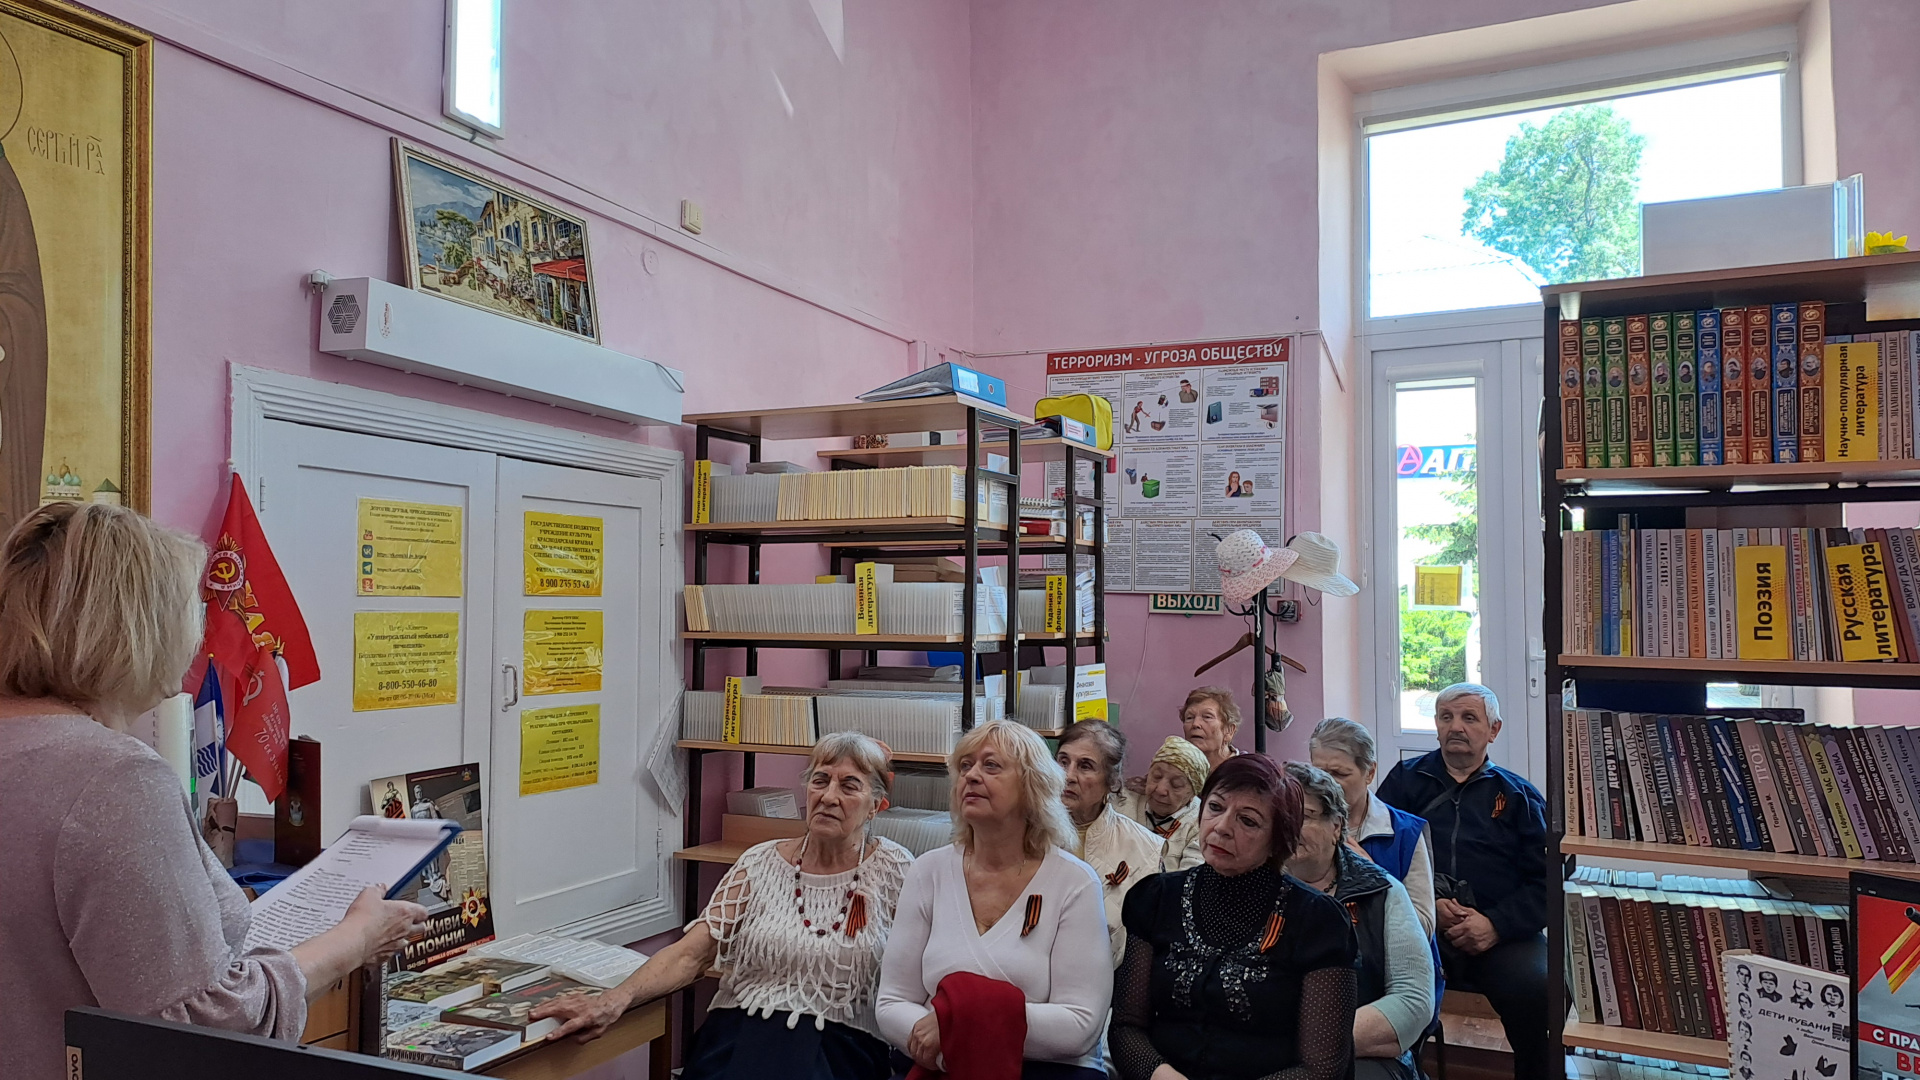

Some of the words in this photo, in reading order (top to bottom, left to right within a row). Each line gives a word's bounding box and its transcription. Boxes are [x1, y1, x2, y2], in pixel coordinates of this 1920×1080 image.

[1053, 353, 1132, 369] ТЕРРОРИЗМ
[1144, 349, 1196, 364] УГРОЗА
[1201, 343, 1282, 361] ОБЩЕСТВУ
[1889, 337, 1898, 366] СЛЕПЫЕ
[1838, 346, 1850, 457] Научно-популярная
[1856, 365, 1869, 437] литература
[1890, 370, 1899, 418] ЗНАМЕНИТЫЕ
[1673, 534, 1683, 562] СОБЫТИЙ
[1706, 534, 1714, 570] ШЕДЕВРОВ
[1792, 533, 1800, 551] ДЕТЕЙ
[1890, 535, 1904, 563] ОКОЛО
[1905, 536, 1918, 563] ОКОЛО
[1660, 542, 1668, 587] ЗВЕРИ
[1898, 565, 1908, 576] ДА
[546, 578, 557, 587] 900
[1049, 580, 1054, 590] на
[1676, 565, 1684, 609] ИСТОРИЧЕСКИХ
[1707, 572, 1715, 606] МИРОВЫХ
[1794, 568, 1804, 616] СТИХОТВОРЕНИЯ
[1901, 579, 1916, 609] ВОКРУГ
[866, 567, 874, 628] литература
[1055, 577, 1063, 632] флеш-картах
[1157, 594, 1217, 610] ВЫХОД
[1691, 586, 1699, 609] КЛАДЫ
[1754, 562, 1773, 641] Поэзия
[1837, 563, 1864, 641] Русская
[1861, 544, 1892, 656] литература
[378, 679, 437, 690] 8-800-550-46-80
[724, 677, 732, 742] Историческая
[730, 683, 738, 738] литература
[1578, 719, 1588, 749] ЛЮБВИ
[1591, 719, 1600, 746] ЛЮБВИ
[1603, 726, 1615, 756] УЗАЛА
[1624, 724, 1639, 767] ЧАЙКА
[1634, 724, 1646, 749] СТАЯ
[1645, 723, 1662, 758] АЛЛЕИ
[1662, 726, 1673, 752] Рассказы
[1676, 730, 1686, 756] Рассказы
[1687, 725, 1701, 761] Маргарита
[1700, 724, 1713, 760] Маргарита
[1771, 741, 1780, 755] МИР
[1846, 739, 1862, 773] открытие
[1858, 737, 1875, 772] открытие
[1875, 733, 1888, 762] Чегема
[1896, 734, 1909, 763] Чегема
[1582, 751, 1591, 781] ВЕРСТЫ
[1595, 751, 1604, 781] ВЕРСТЫ
[1606, 759, 1620, 788] ДЕРСУ
[1641, 752, 1655, 794] ВОЛЧЬЯ
[1748, 743, 1769, 783] ТРОЕ
[1798, 758, 1814, 792] АНТИЧНОЙ
[1815, 751, 1828, 774] БЫКА
[1832, 752, 1846, 775] БЫКА
[1886, 763, 1892, 772] из
[1653, 761, 1674, 806] ТЕМНЫЕ
[1697, 768, 1709, 793] Мастер
[1712, 768, 1723, 792] Мастер
[1777, 758, 1797, 805] БЛИСТАЮЩИЙ
[1823, 777, 1834, 794] ЧАС
[1841, 778, 1852, 794] ЧАС
[1859, 774, 1874, 802] Первое
[1872, 772, 1887, 801] Первое
[1890, 773, 1905, 804] Сандро
[1638, 788, 1647, 814] Бирюков
[1706, 799, 1717, 825] Булгаков
[1721, 799, 1731, 825] Булгаков
[1768, 802, 1780, 828] Горький
[1811, 794, 1824, 820] ГОЛОВА
[1866, 846, 1873, 854] 2
[1886, 846, 1895, 855] 1
[1899, 846, 1908, 855] 2
[424, 914, 461, 937] ЖИВИ
[1568, 901, 1586, 957] Дружба
[1624, 903, 1636, 927] КАЗАК
[1642, 906, 1652, 928] КАЗАК
[1660, 909, 1674, 947] ФРЕГАТЫ
[1693, 910, 1705, 940] флоксов
[1708, 912, 1721, 938] ХОРОШО
[1751, 916, 1760, 935] ТЕНИ
[404, 945, 414, 960] И
[416, 928, 466, 956] ПОМНИ!
[1587, 904, 1608, 960] Дружба
[1677, 911, 1691, 949] ФРЕГАТЫ
[1628, 928, 1645, 981] АФРИКАНСКИЙ
[1645, 931, 1662, 985] АФРИКАНСКИЙ
[1699, 941, 1708, 961] запах
[1668, 949, 1682, 985] ТАЙНЫЕ
[1685, 950, 1699, 986] ТАЙНЫЕ
[1702, 962, 1714, 990] Вечный
[1579, 968, 1588, 999] Коптяева
[1602, 972, 1612, 1003] Коптяева
[1758, 1008, 1785, 1021] ДЕТИ
[1787, 1015, 1831, 1033] КУБАНИ
[1872, 1029, 1884, 1041] С
